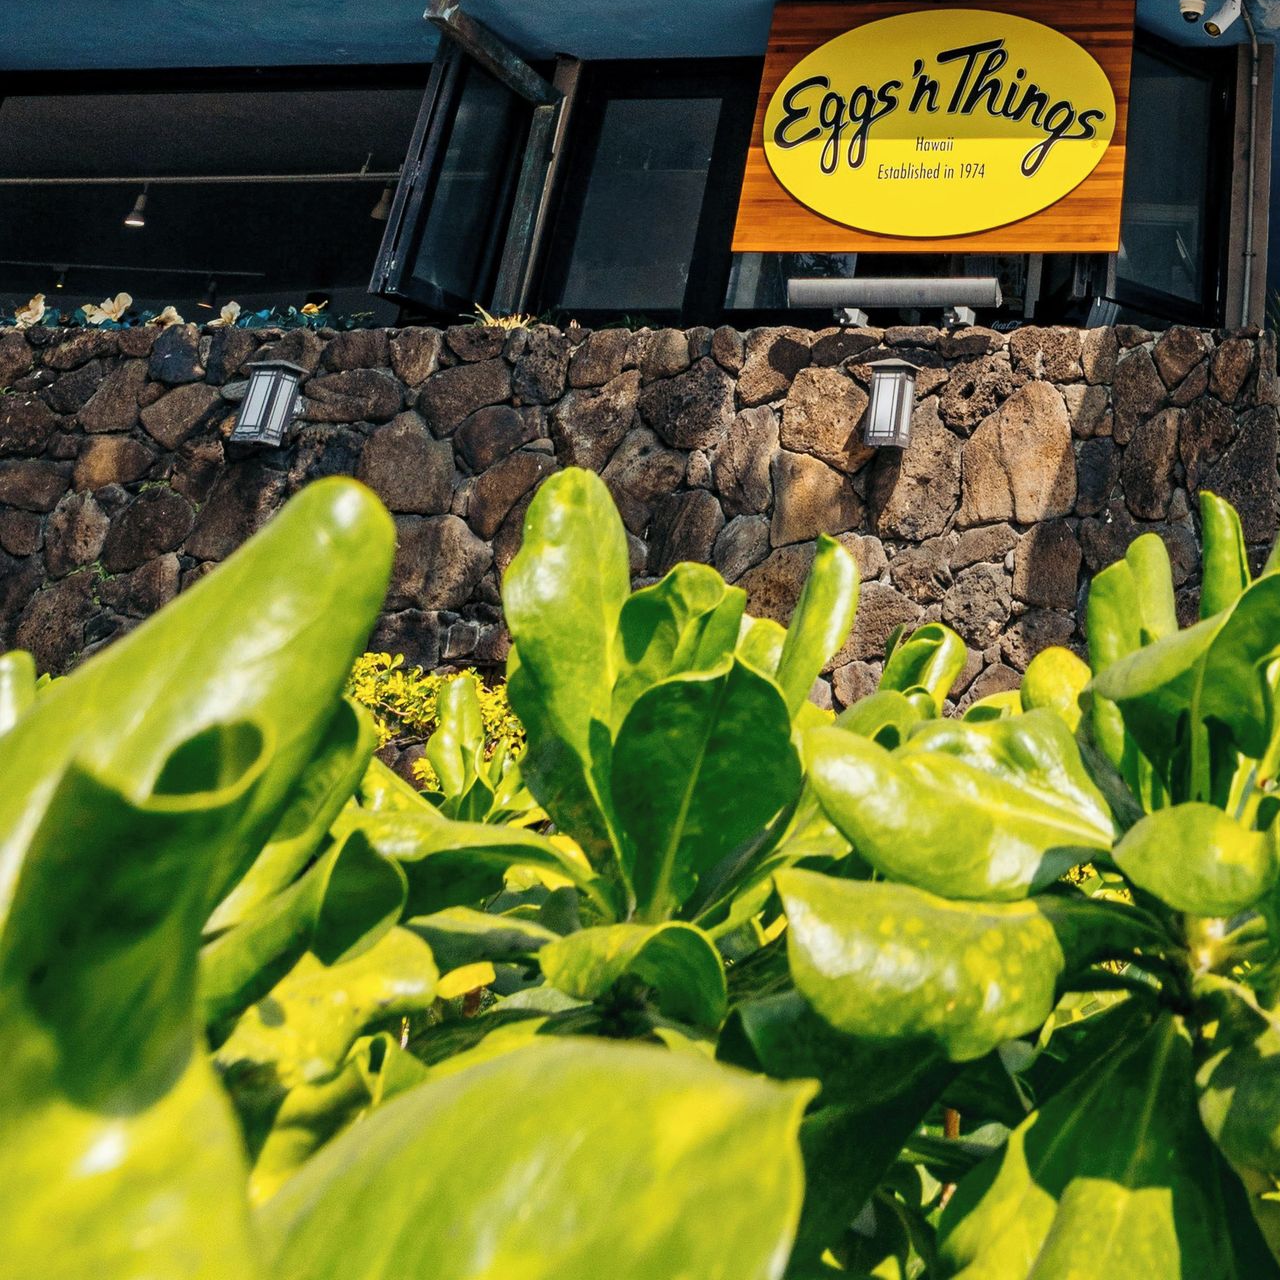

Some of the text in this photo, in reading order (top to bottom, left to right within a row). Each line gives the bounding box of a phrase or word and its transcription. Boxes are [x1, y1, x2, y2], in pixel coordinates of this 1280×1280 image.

[773, 75, 902, 175] Eggs
[936, 38, 1106, 179] Things
[915, 136, 955, 151] Hawaii
[877, 162, 985, 179] Established in 1974
